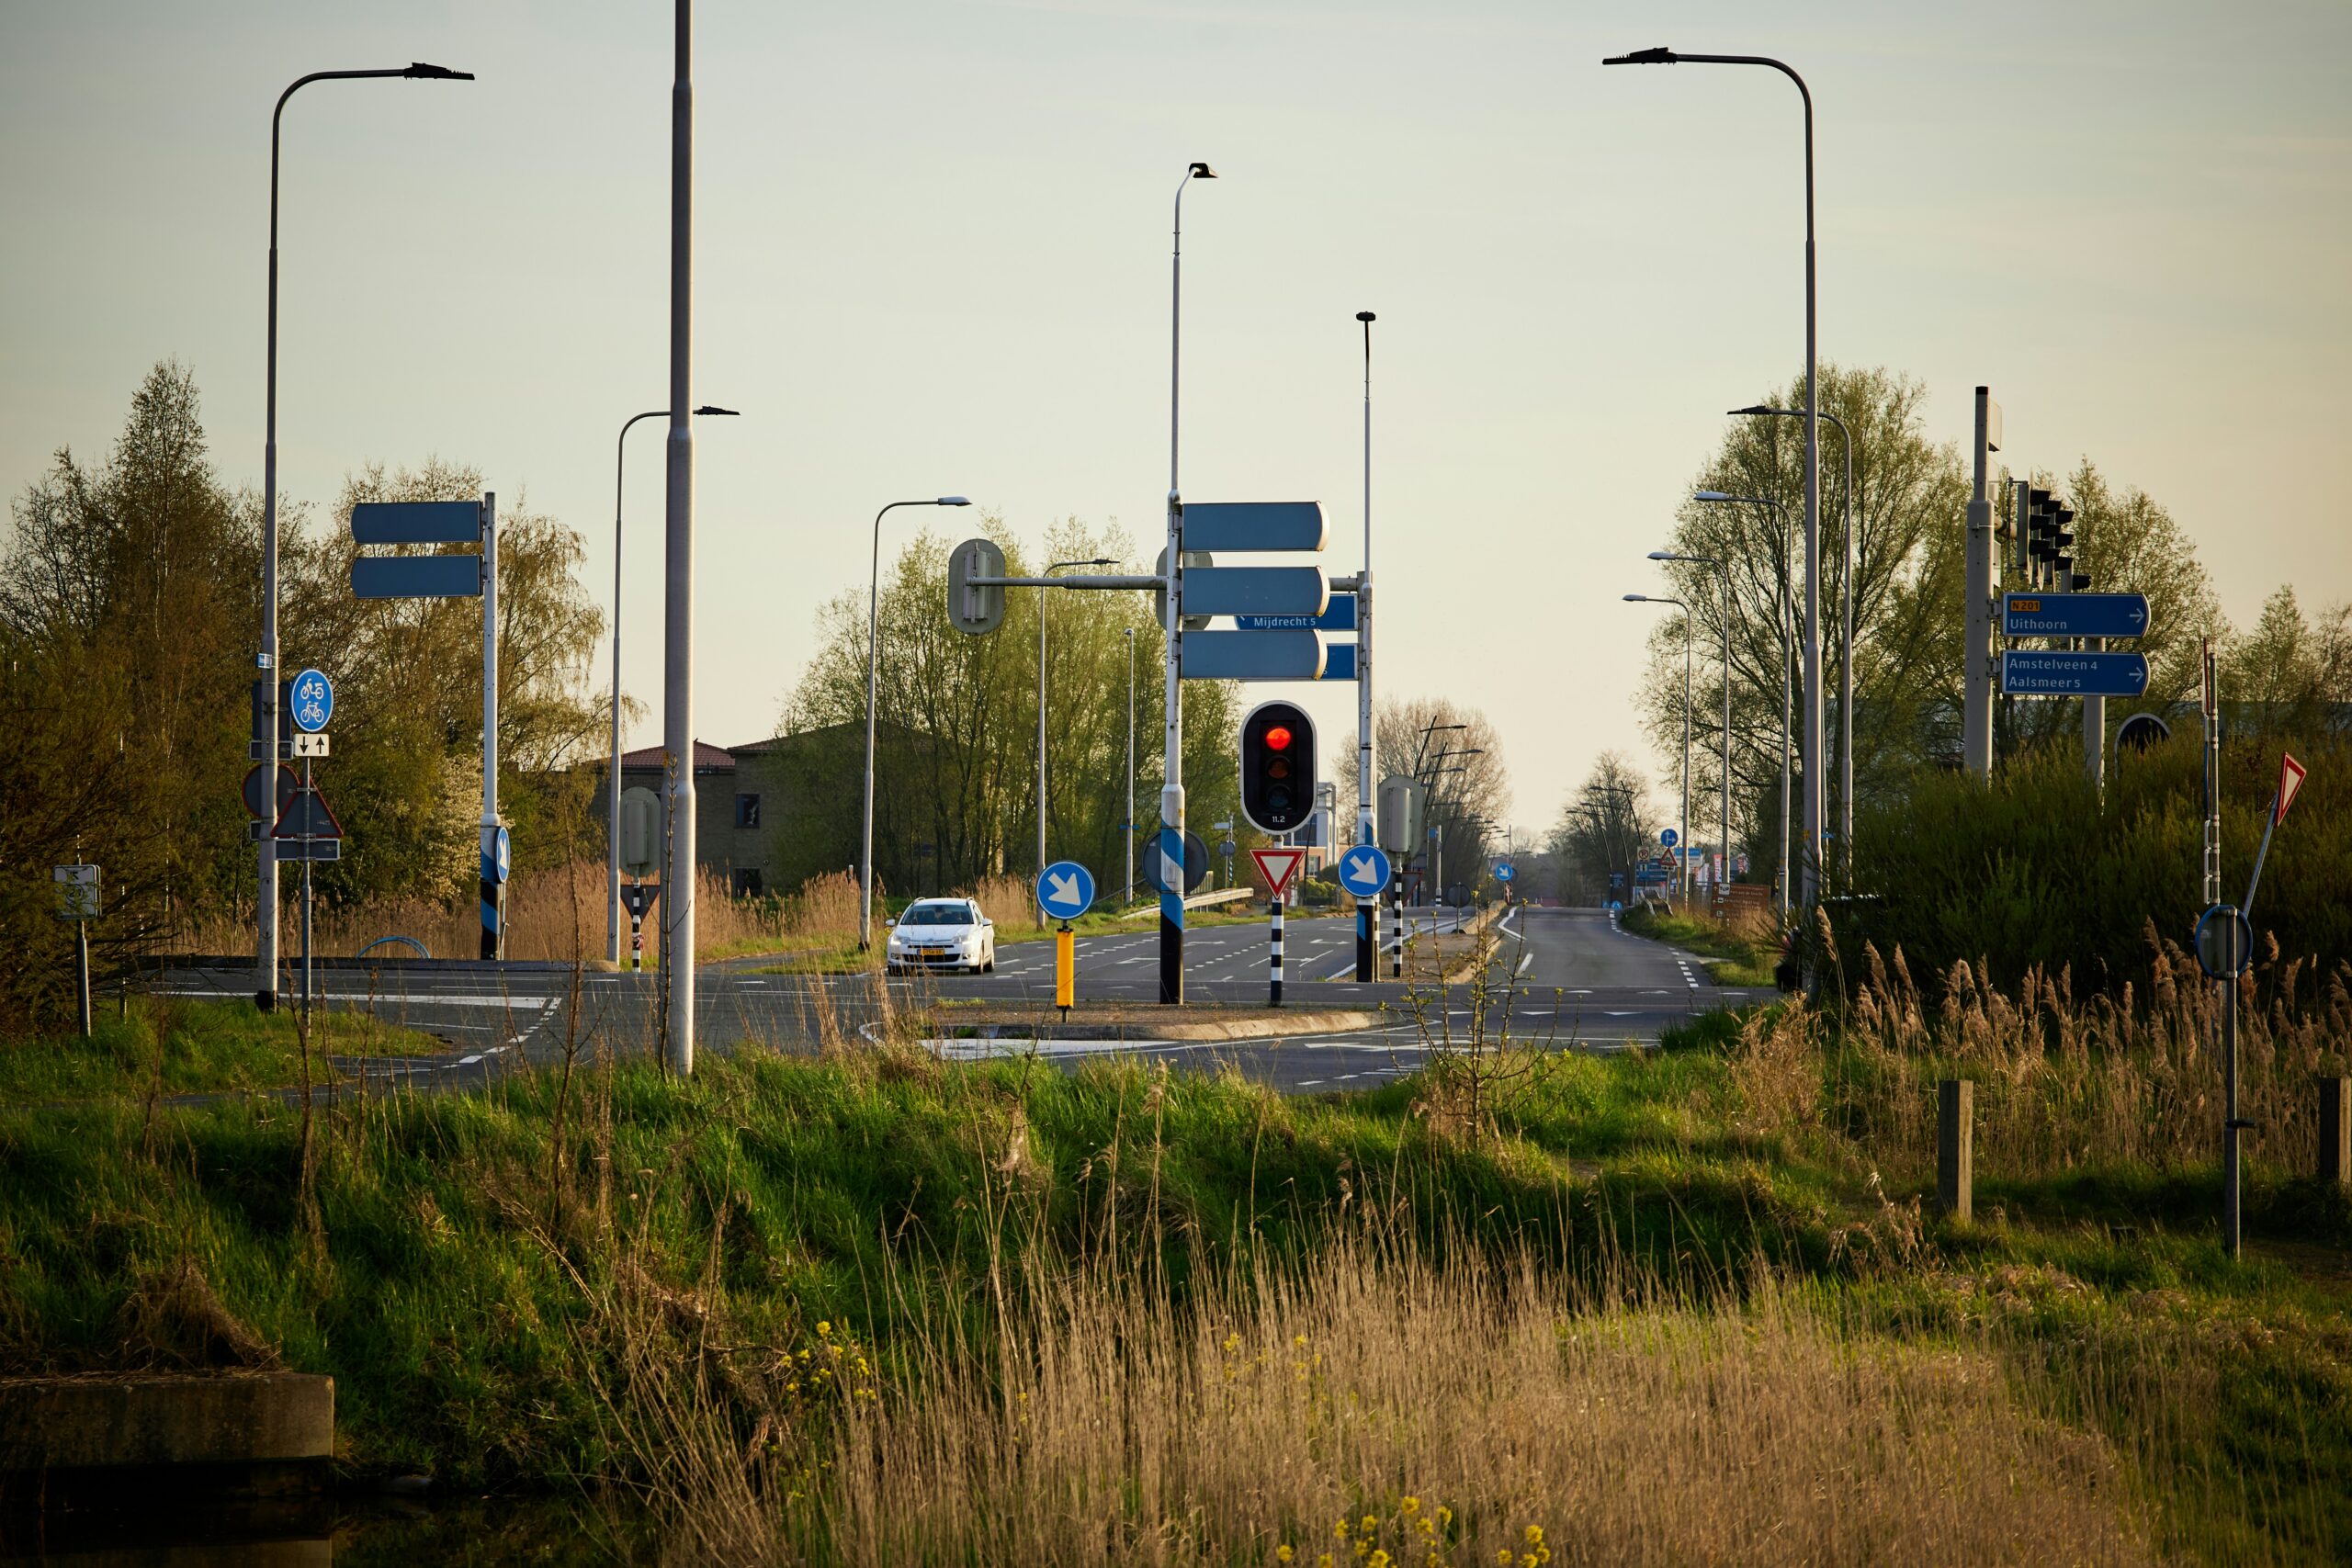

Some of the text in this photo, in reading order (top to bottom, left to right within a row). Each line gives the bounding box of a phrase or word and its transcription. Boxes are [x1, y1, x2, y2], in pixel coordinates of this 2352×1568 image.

[1254, 616, 1316, 628] Mijdrecht 5
[2010, 618, 2067, 629] Uithoorn
[2009, 658, 2098, 670] Amstelveen 4
[2009, 676, 2080, 688] Aalsmeer 5
[1272, 815, 1285, 823] 11.2
